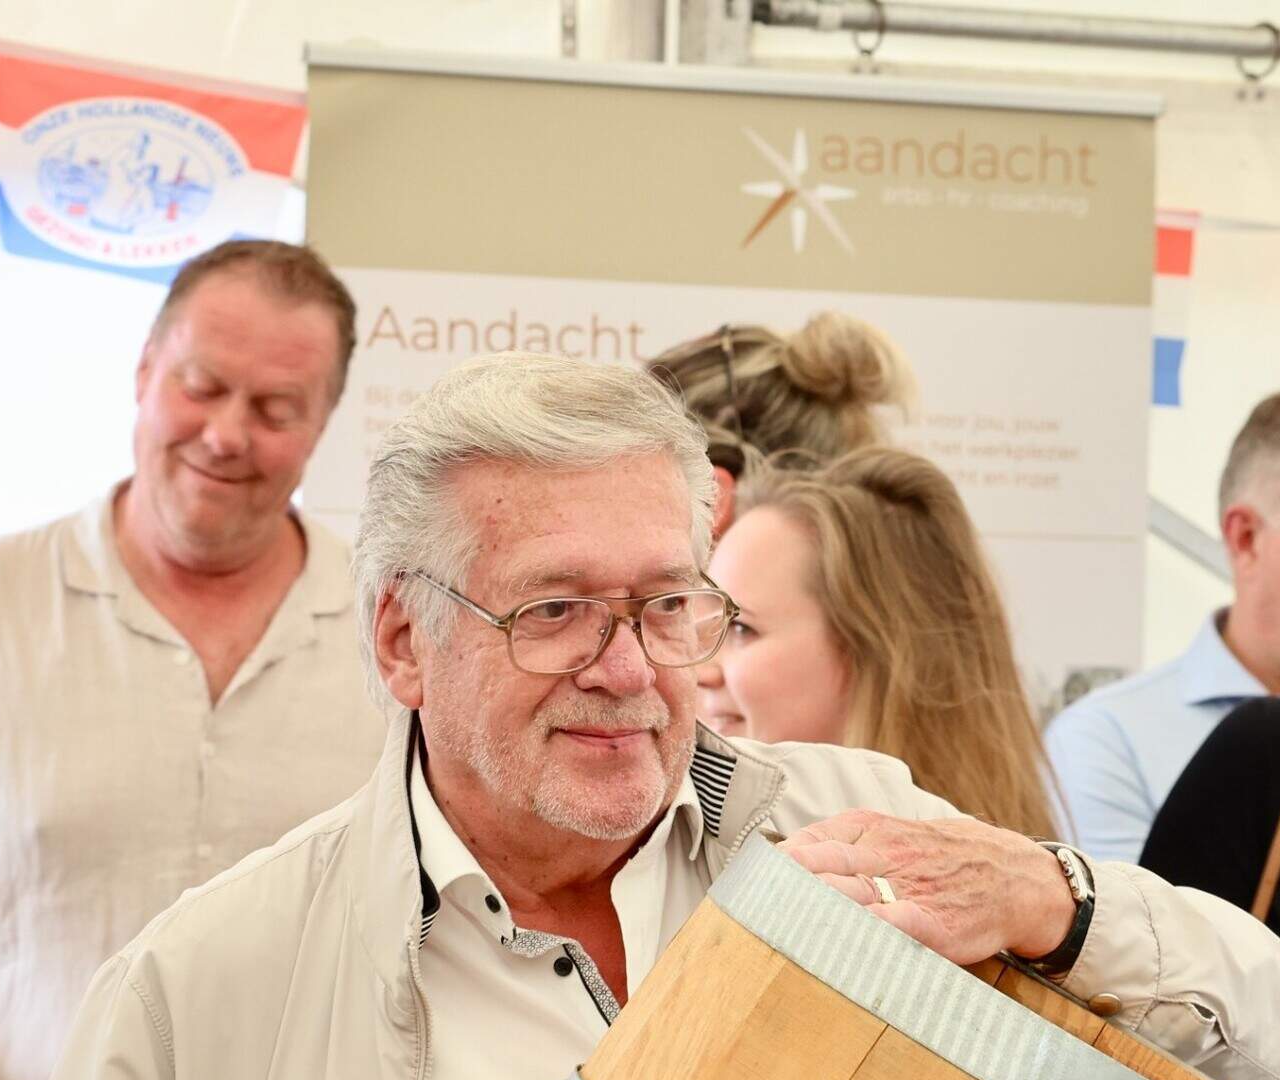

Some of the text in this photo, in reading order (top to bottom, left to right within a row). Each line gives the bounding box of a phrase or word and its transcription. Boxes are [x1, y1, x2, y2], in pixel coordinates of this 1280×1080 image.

[23, 108, 71, 143] ONZE
[78, 101, 191, 129] HOLLANDSE
[821, 127, 1097, 188] aandacht
[365, 304, 648, 365] Aandacht
